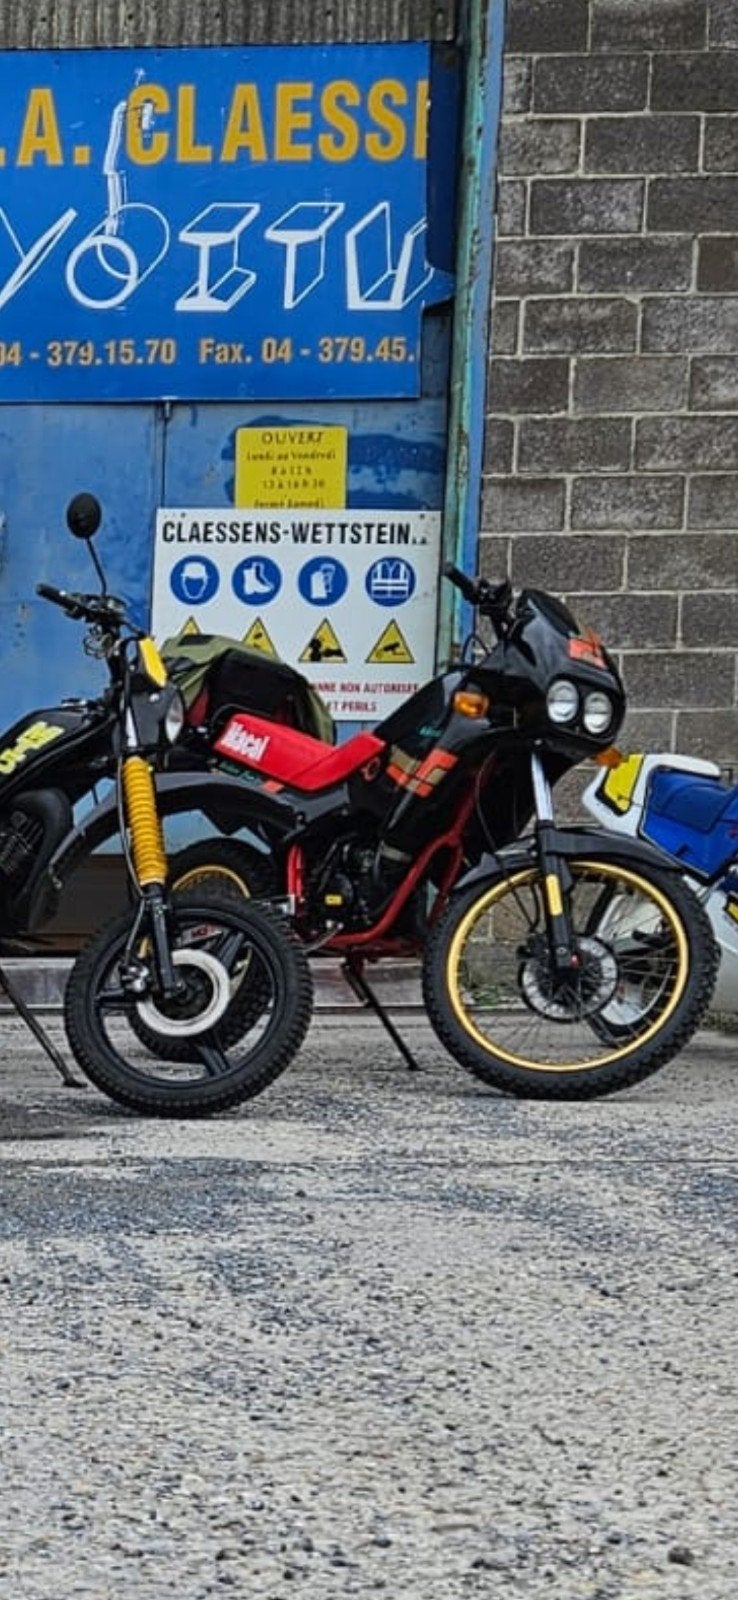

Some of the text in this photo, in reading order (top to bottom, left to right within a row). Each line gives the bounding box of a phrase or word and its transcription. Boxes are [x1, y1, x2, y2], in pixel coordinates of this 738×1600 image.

[47, 338, 177, 367] 379.15.70
[198, 337, 252, 364] Fax.
[261, 337, 292, 364] 04
[261, 431, 324, 446] OUVERT
[161, 521, 411, 545] CLAESSENS-WETTSTEIN
[341, 683, 361, 693] NON
